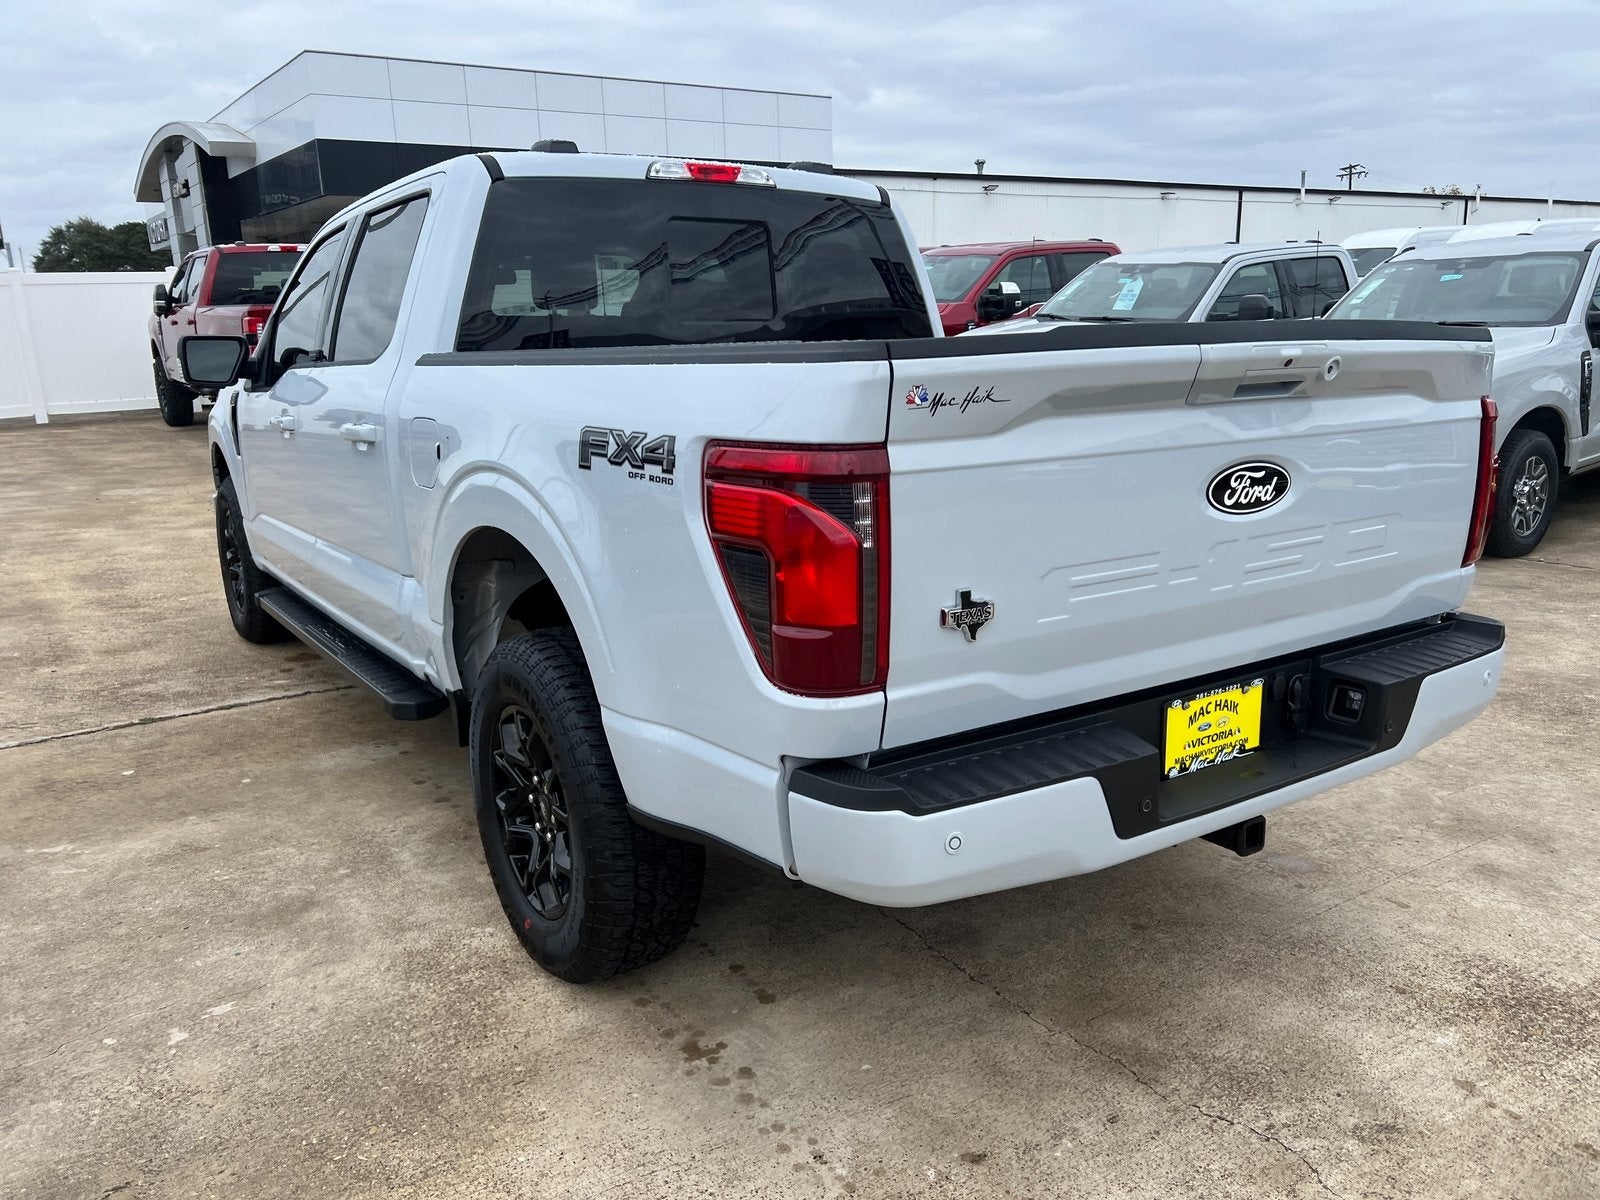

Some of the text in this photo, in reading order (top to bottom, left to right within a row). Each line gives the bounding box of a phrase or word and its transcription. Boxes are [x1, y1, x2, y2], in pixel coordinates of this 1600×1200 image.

[926, 386, 1011, 417] Mac Haik
[578, 425, 677, 475] FX4
[628, 471, 674, 486] OFF ROAD
[1222, 469, 1279, 507] Ford
[948, 604, 992, 625] TEXAS
[1188, 701, 1212, 729] MAC
[1214, 699, 1240, 715] HAIK
[1191, 729, 1234, 749] VICTORIA
[1187, 745, 1254, 773] Mac Haik
